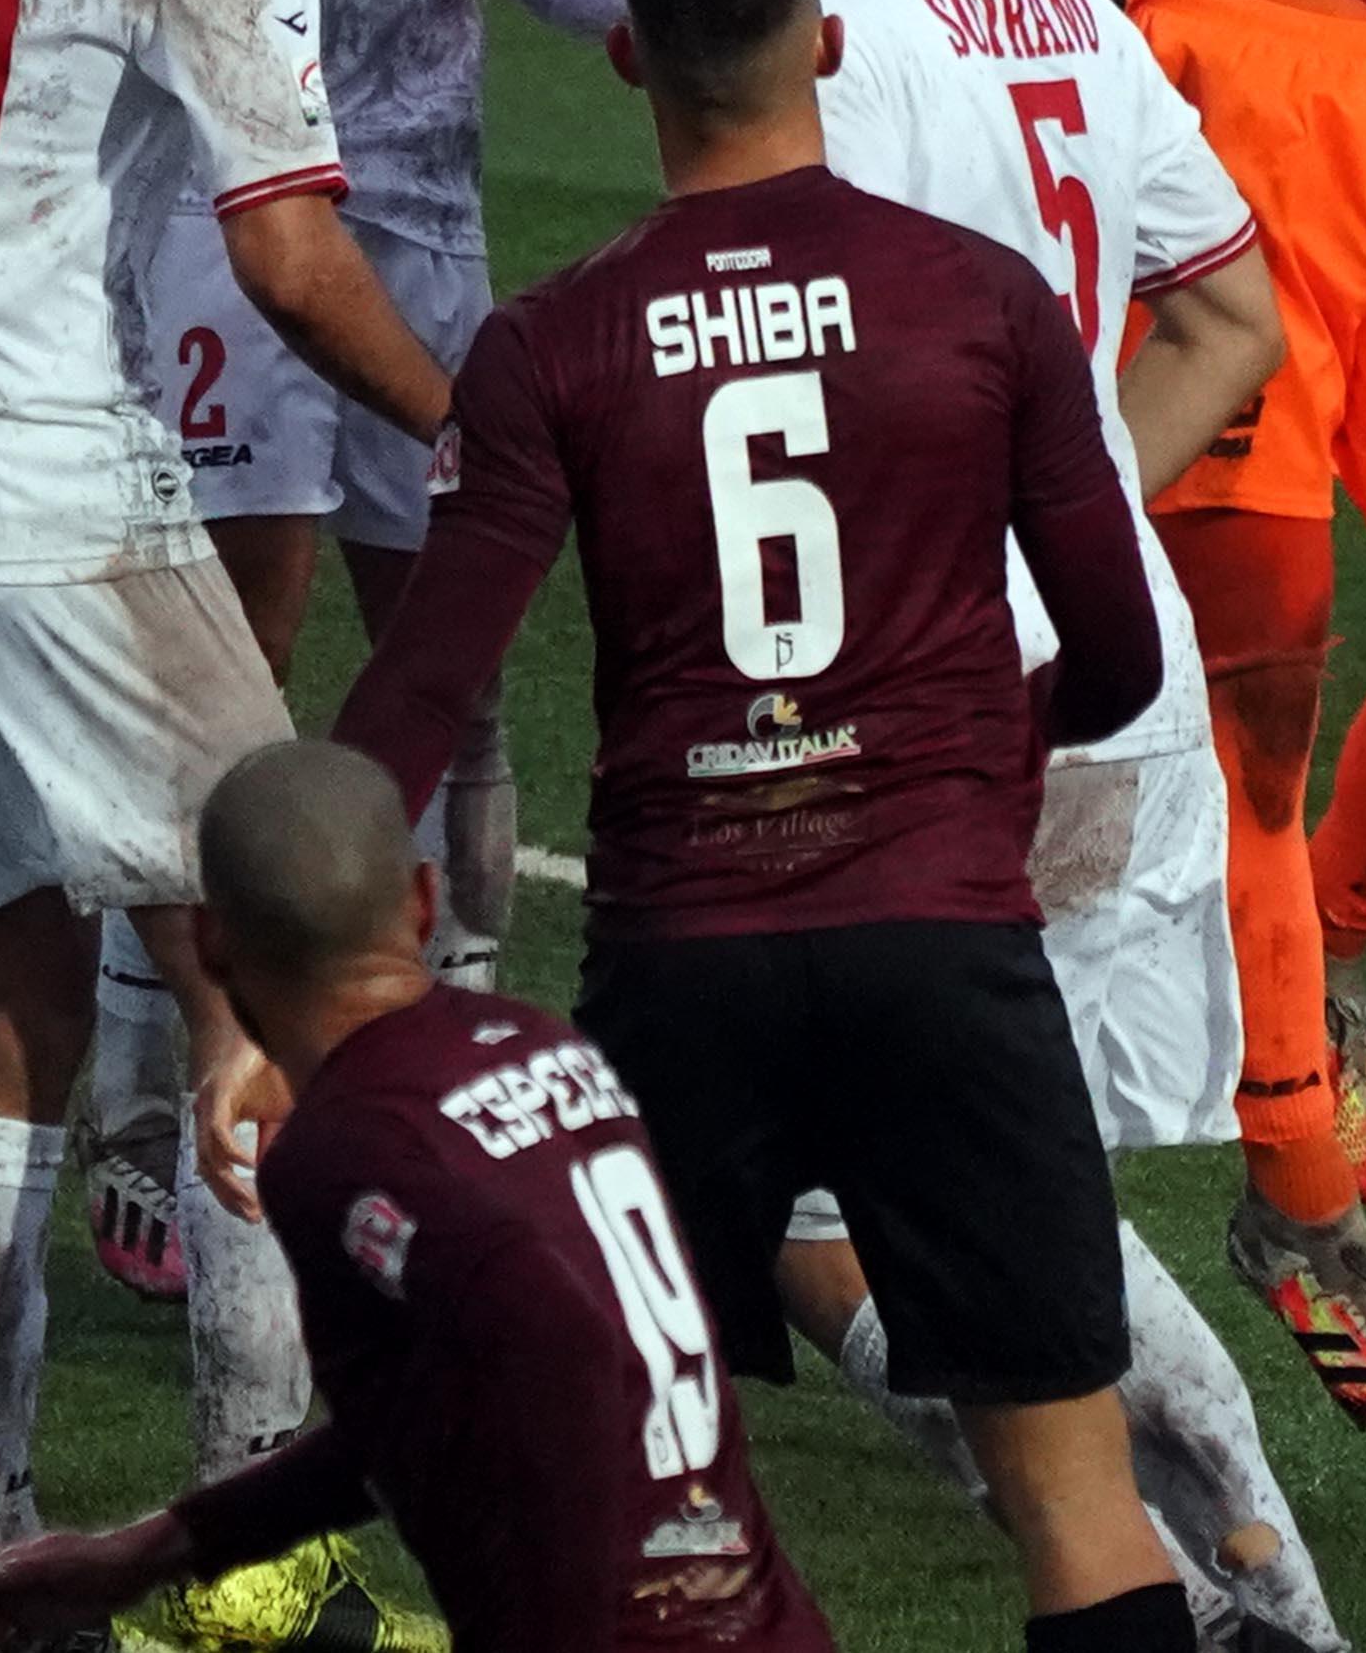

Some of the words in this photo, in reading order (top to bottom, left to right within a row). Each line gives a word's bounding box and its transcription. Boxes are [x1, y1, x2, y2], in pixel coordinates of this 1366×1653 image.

[1006, 78, 1100, 356] 5
[177, 325, 227, 441] 2
[645, 275, 857, 378] SHIBA
[181, 443, 253, 468] GEA
[702, 370, 845, 681] 6
